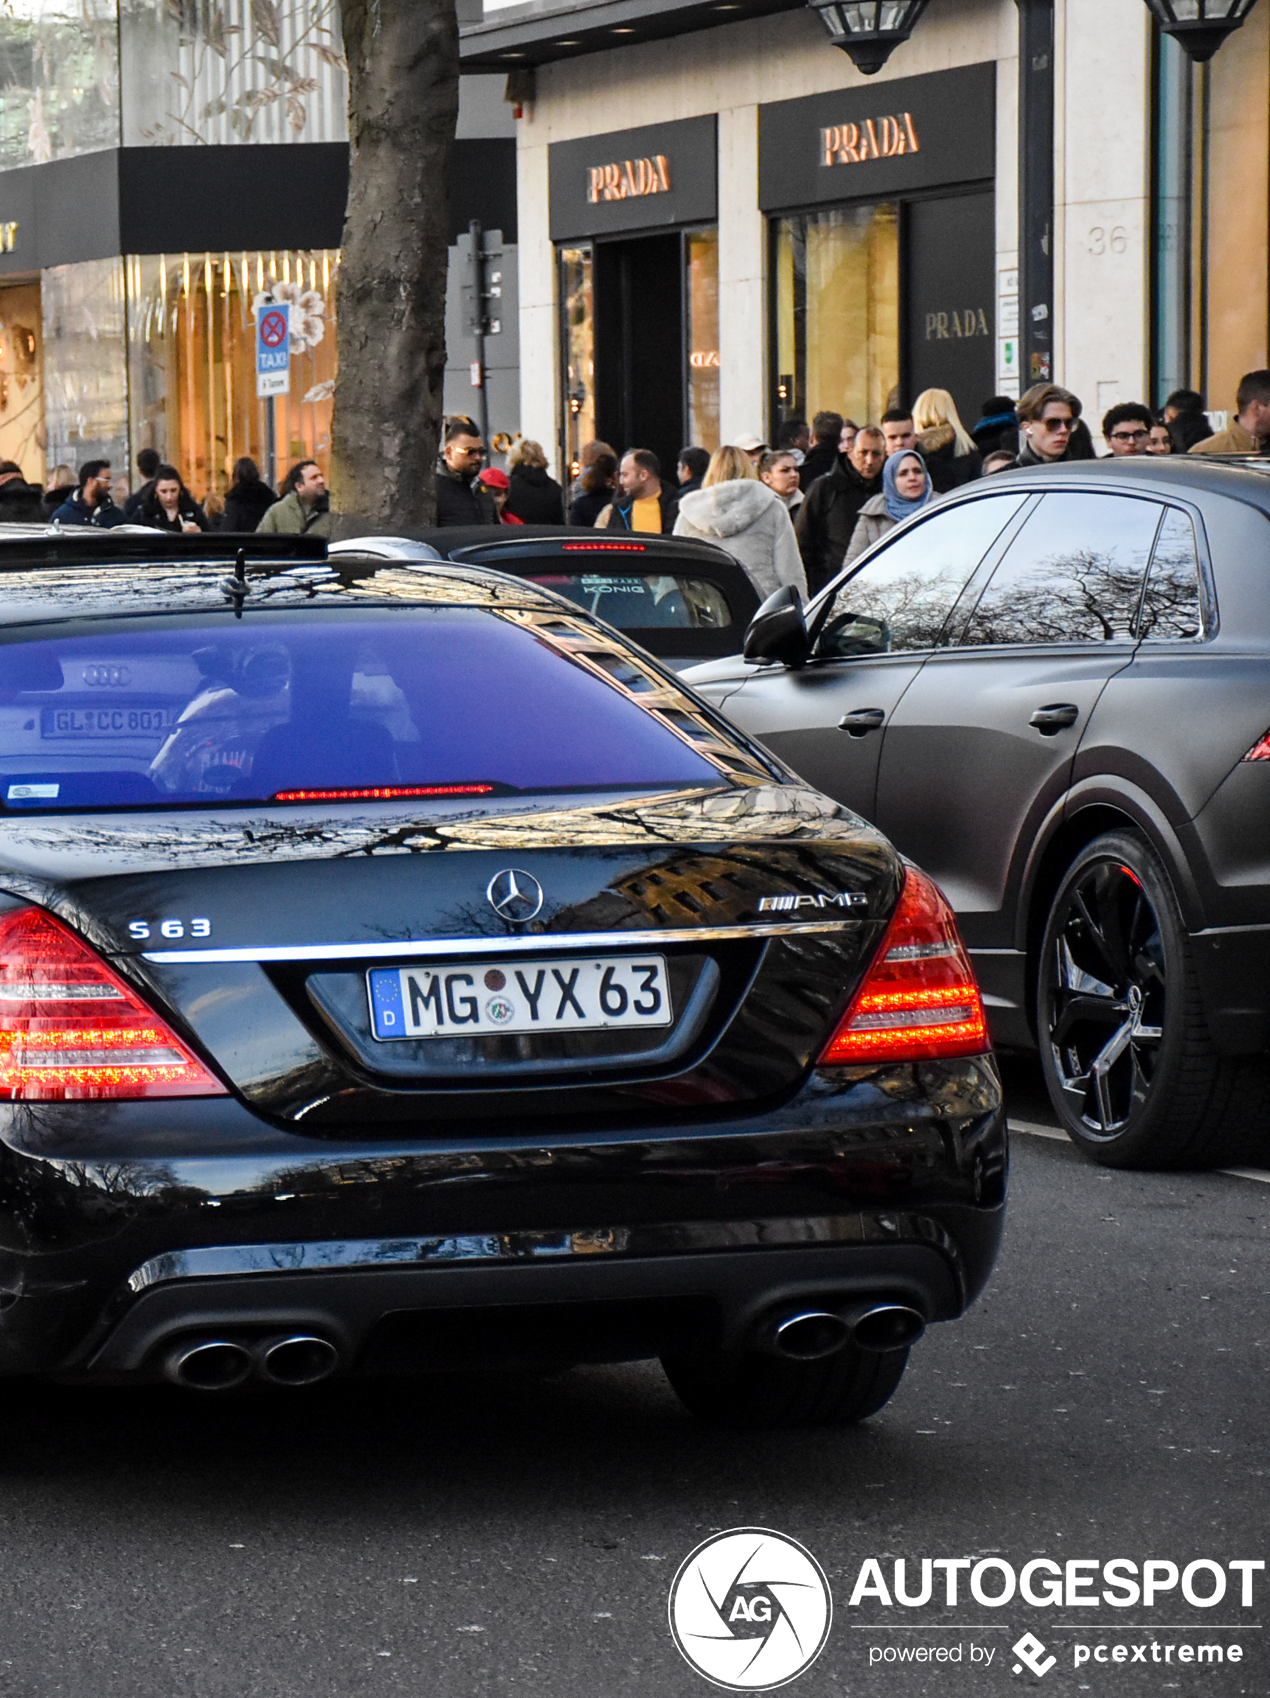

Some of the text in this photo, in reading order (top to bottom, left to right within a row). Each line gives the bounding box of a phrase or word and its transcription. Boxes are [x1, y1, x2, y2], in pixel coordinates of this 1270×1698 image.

[819, 112, 920, 168] PRADA
[587, 154, 671, 204] PRADA
[1088, 225, 1127, 256] 36
[925, 308, 989, 340] PRADA
[259, 351, 287, 369] TAXI
[583, 584, 645, 594] KÖNIG
[56, 711, 83, 731] GL
[97, 711, 124, 731] CC
[793, 892, 868, 910] AMG
[128, 918, 211, 940] S 63
[407, 965, 662, 1027] MG YX 63
[384, 1011, 396, 1026] D
